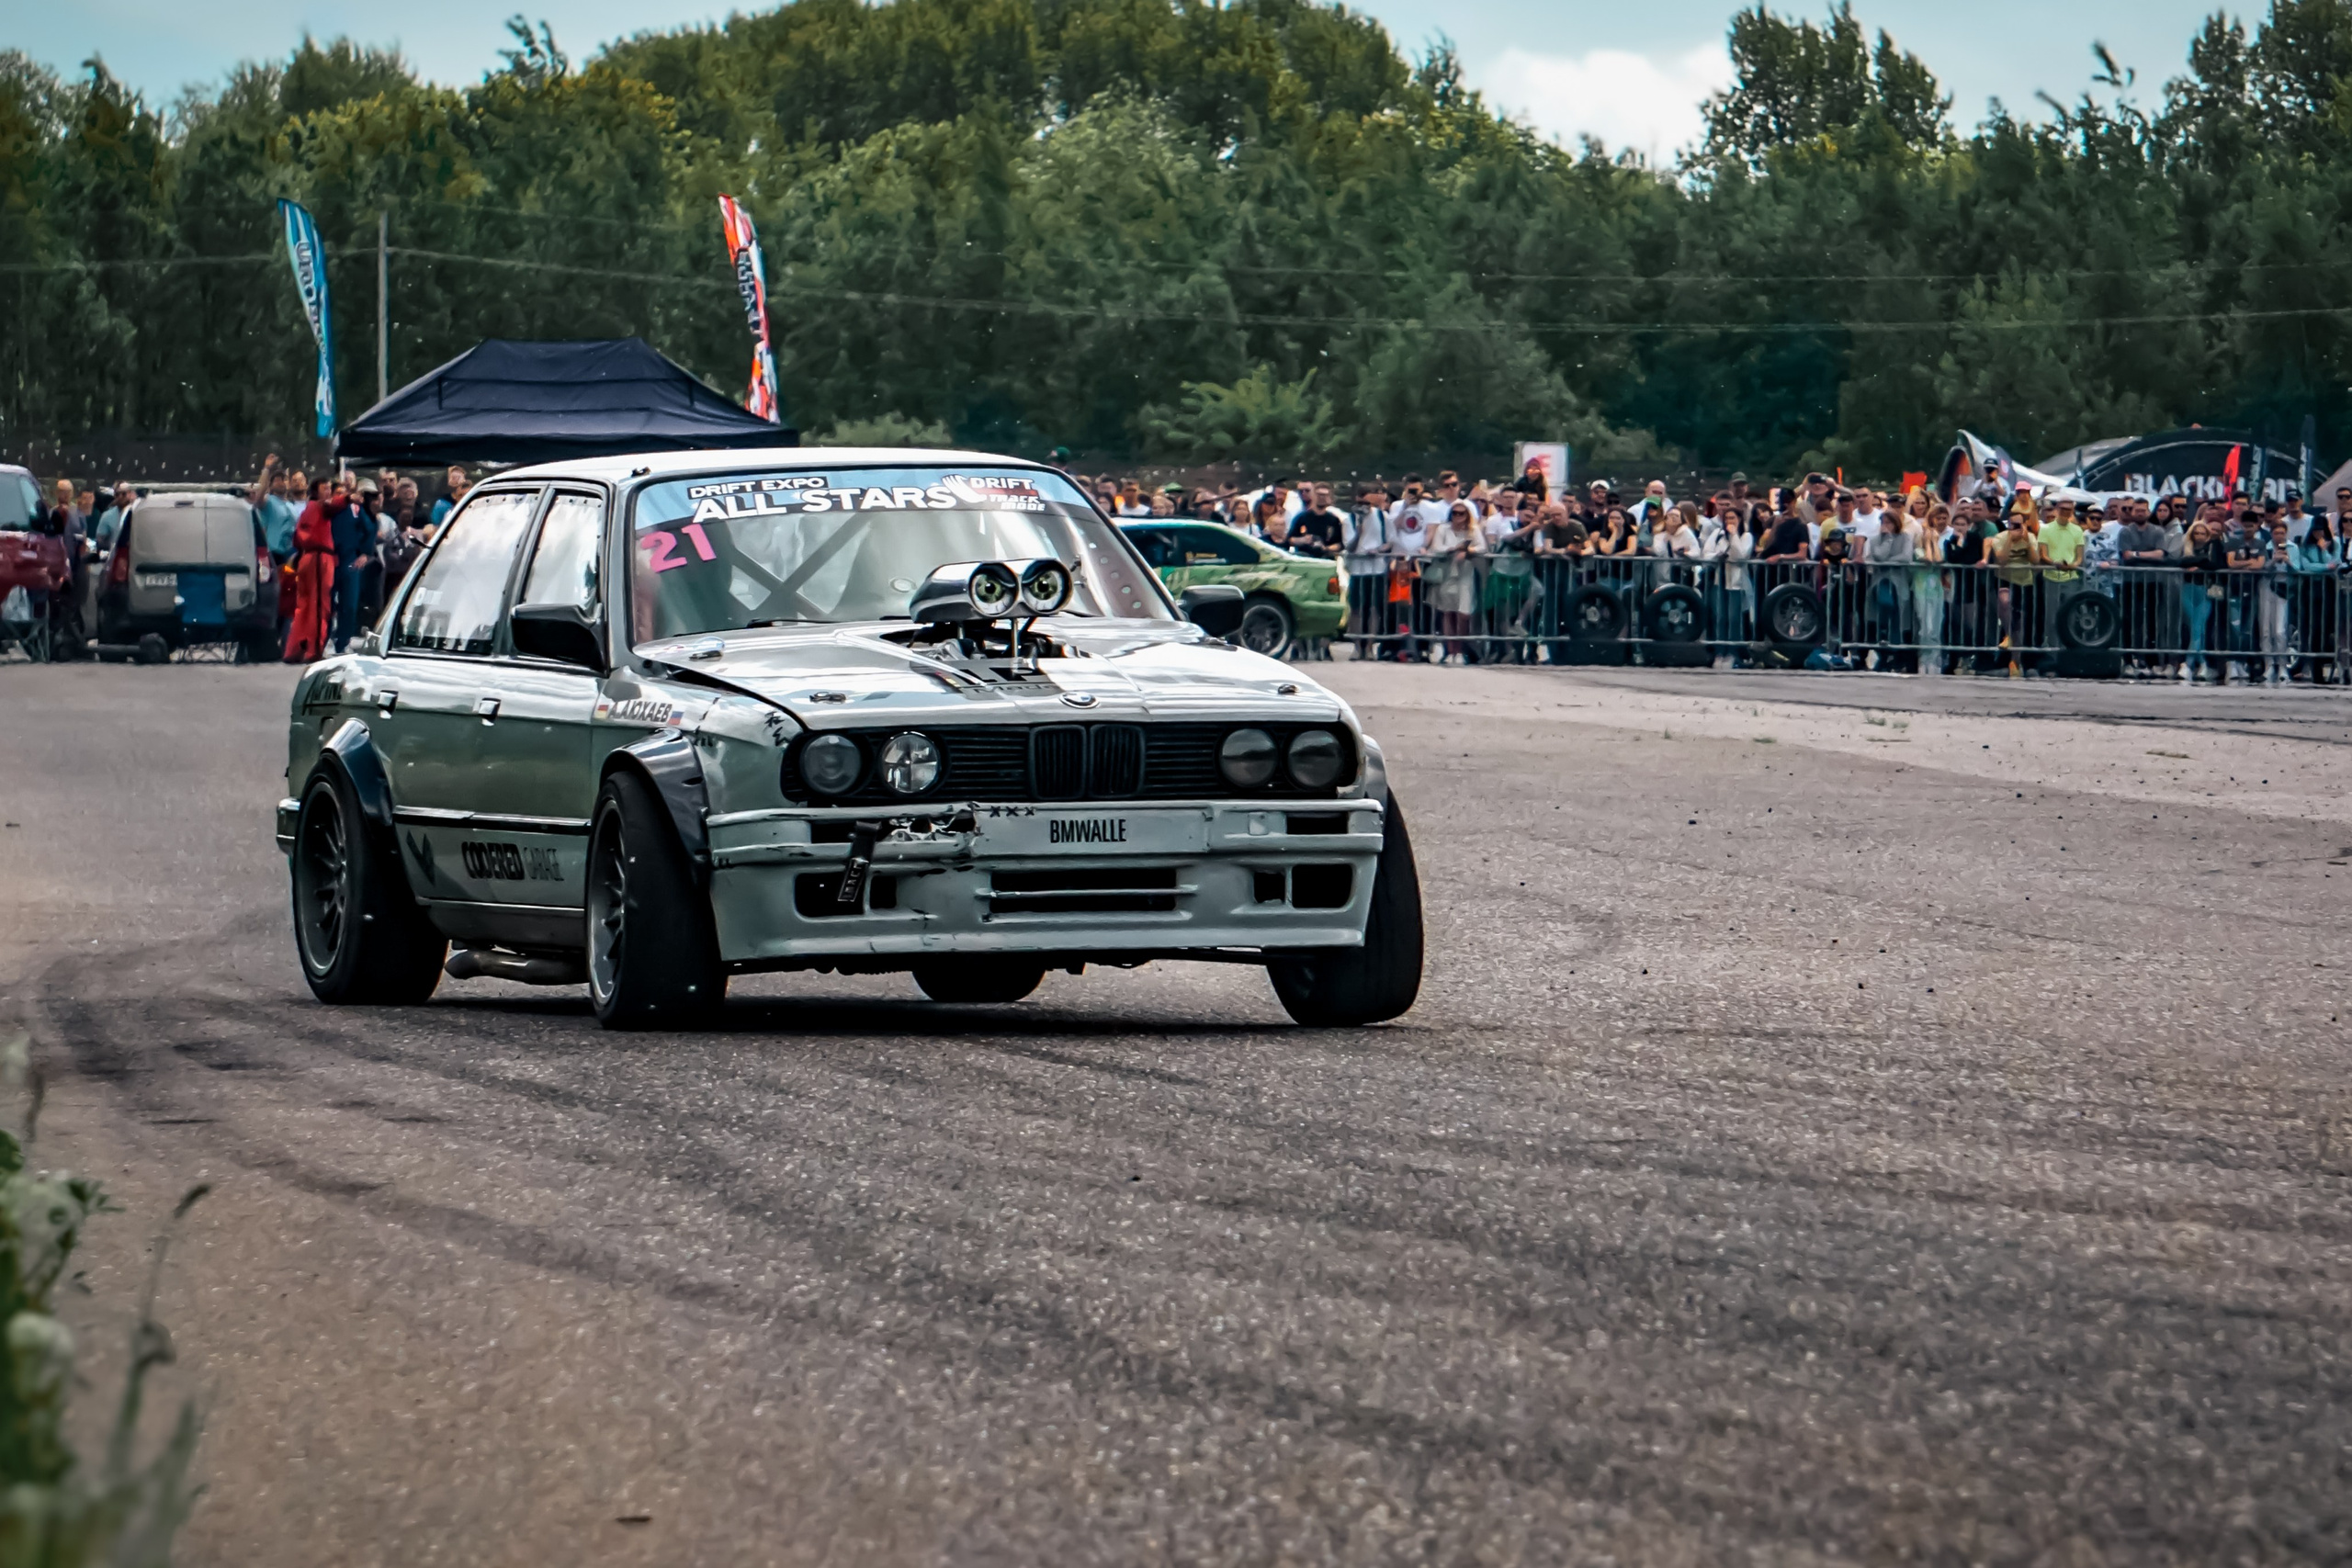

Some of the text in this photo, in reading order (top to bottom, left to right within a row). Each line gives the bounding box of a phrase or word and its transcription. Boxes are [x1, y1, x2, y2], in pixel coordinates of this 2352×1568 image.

[690, 477, 825, 499] DRIFT EXPO
[969, 477, 1034, 490] DRIFT
[693, 486, 957, 524] ALL STARS
[641, 524, 717, 573] 21
[1050, 818, 1127, 843] BMWALLE
